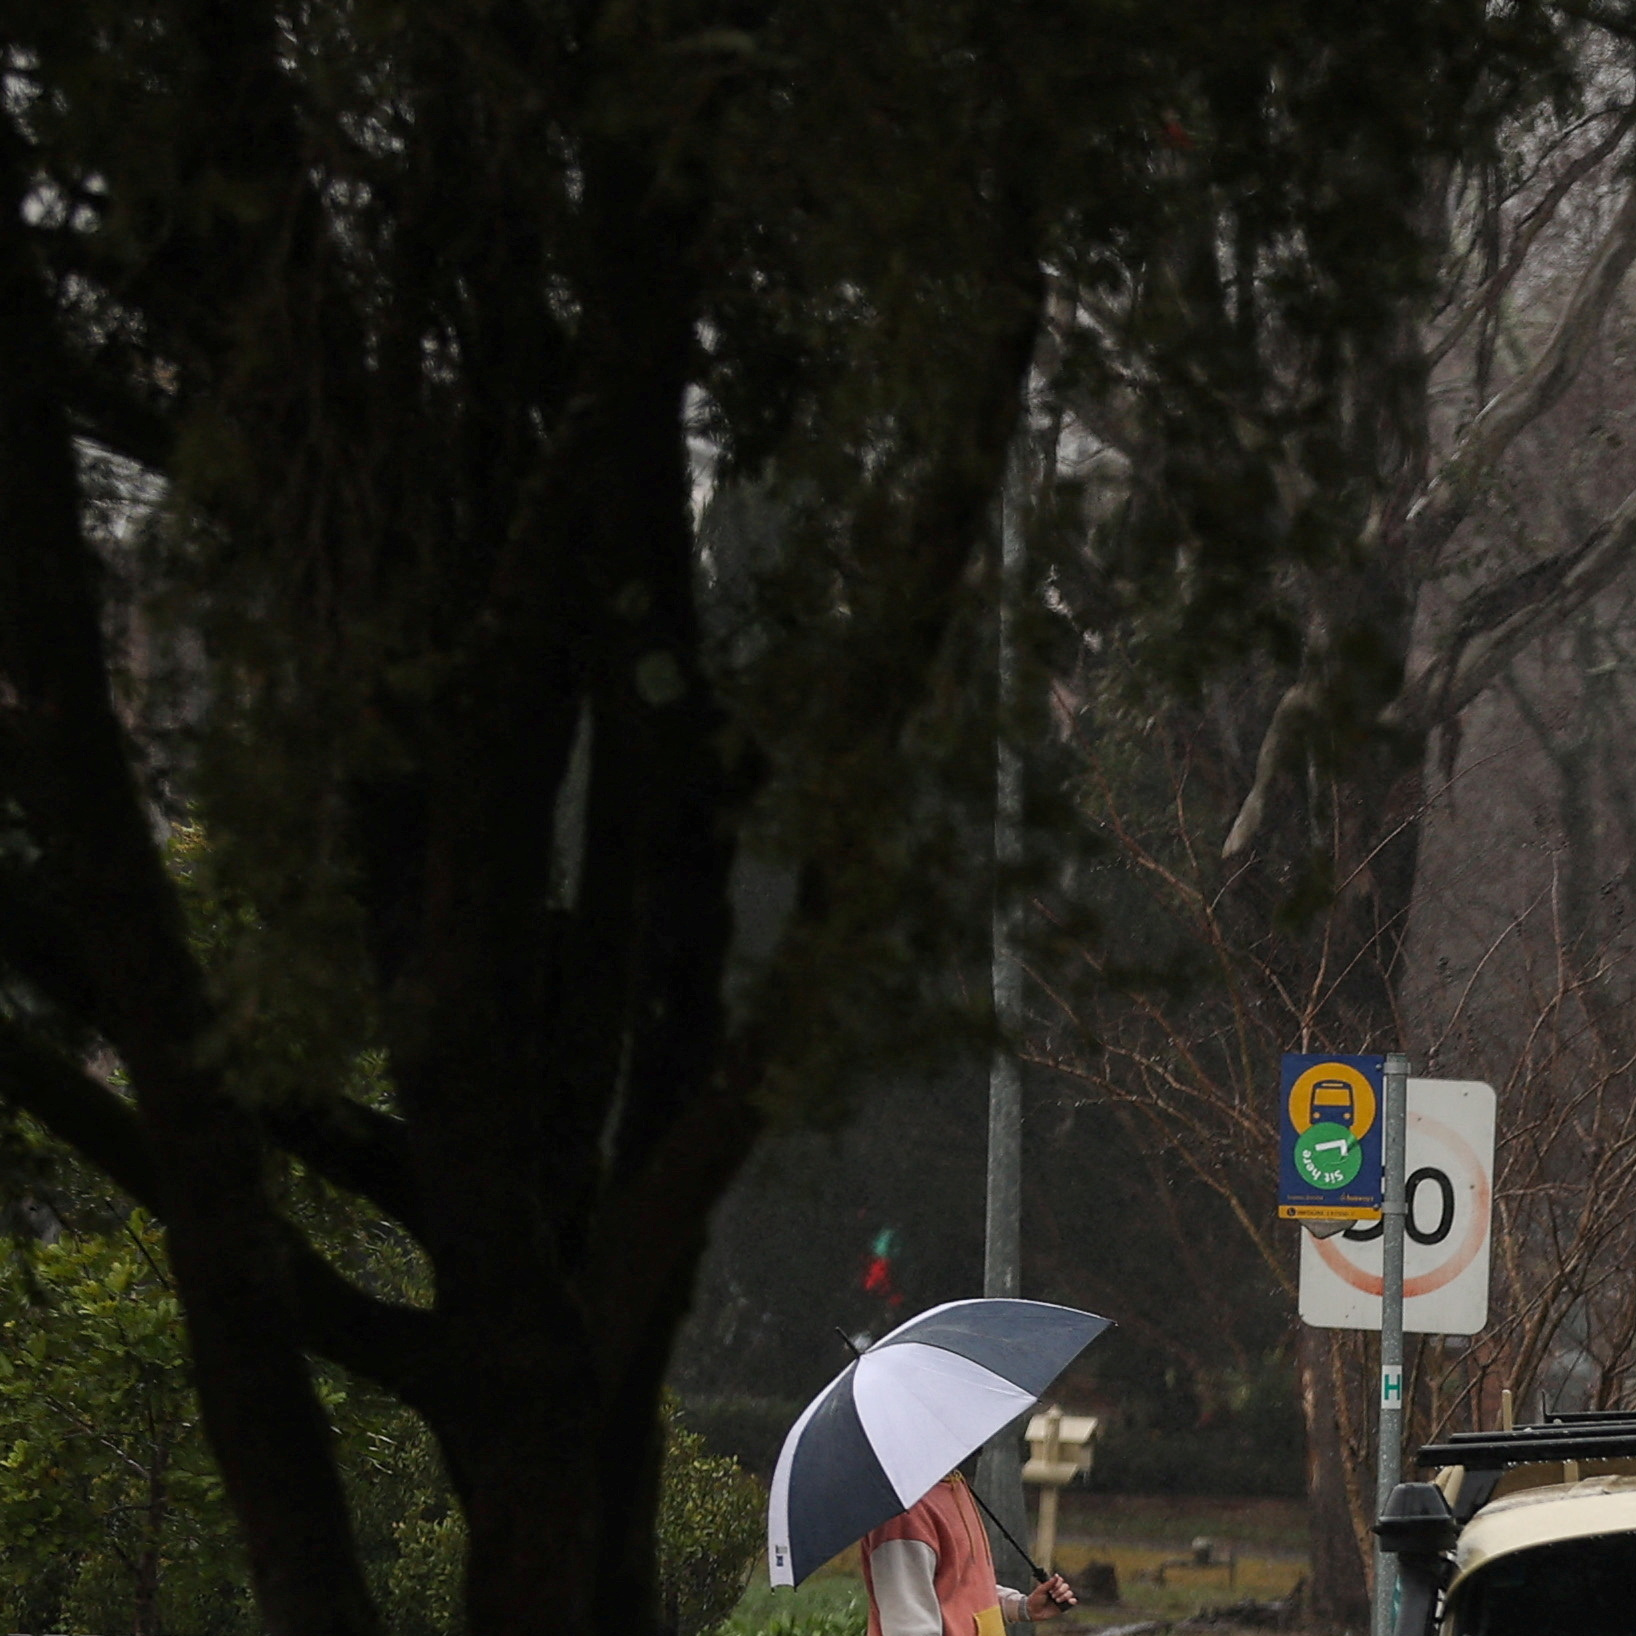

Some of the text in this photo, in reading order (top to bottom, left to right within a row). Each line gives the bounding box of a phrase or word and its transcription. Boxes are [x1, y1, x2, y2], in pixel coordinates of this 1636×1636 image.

[1302, 1149, 1344, 1184] Sit here
[1384, 1374, 1401, 1400] H
